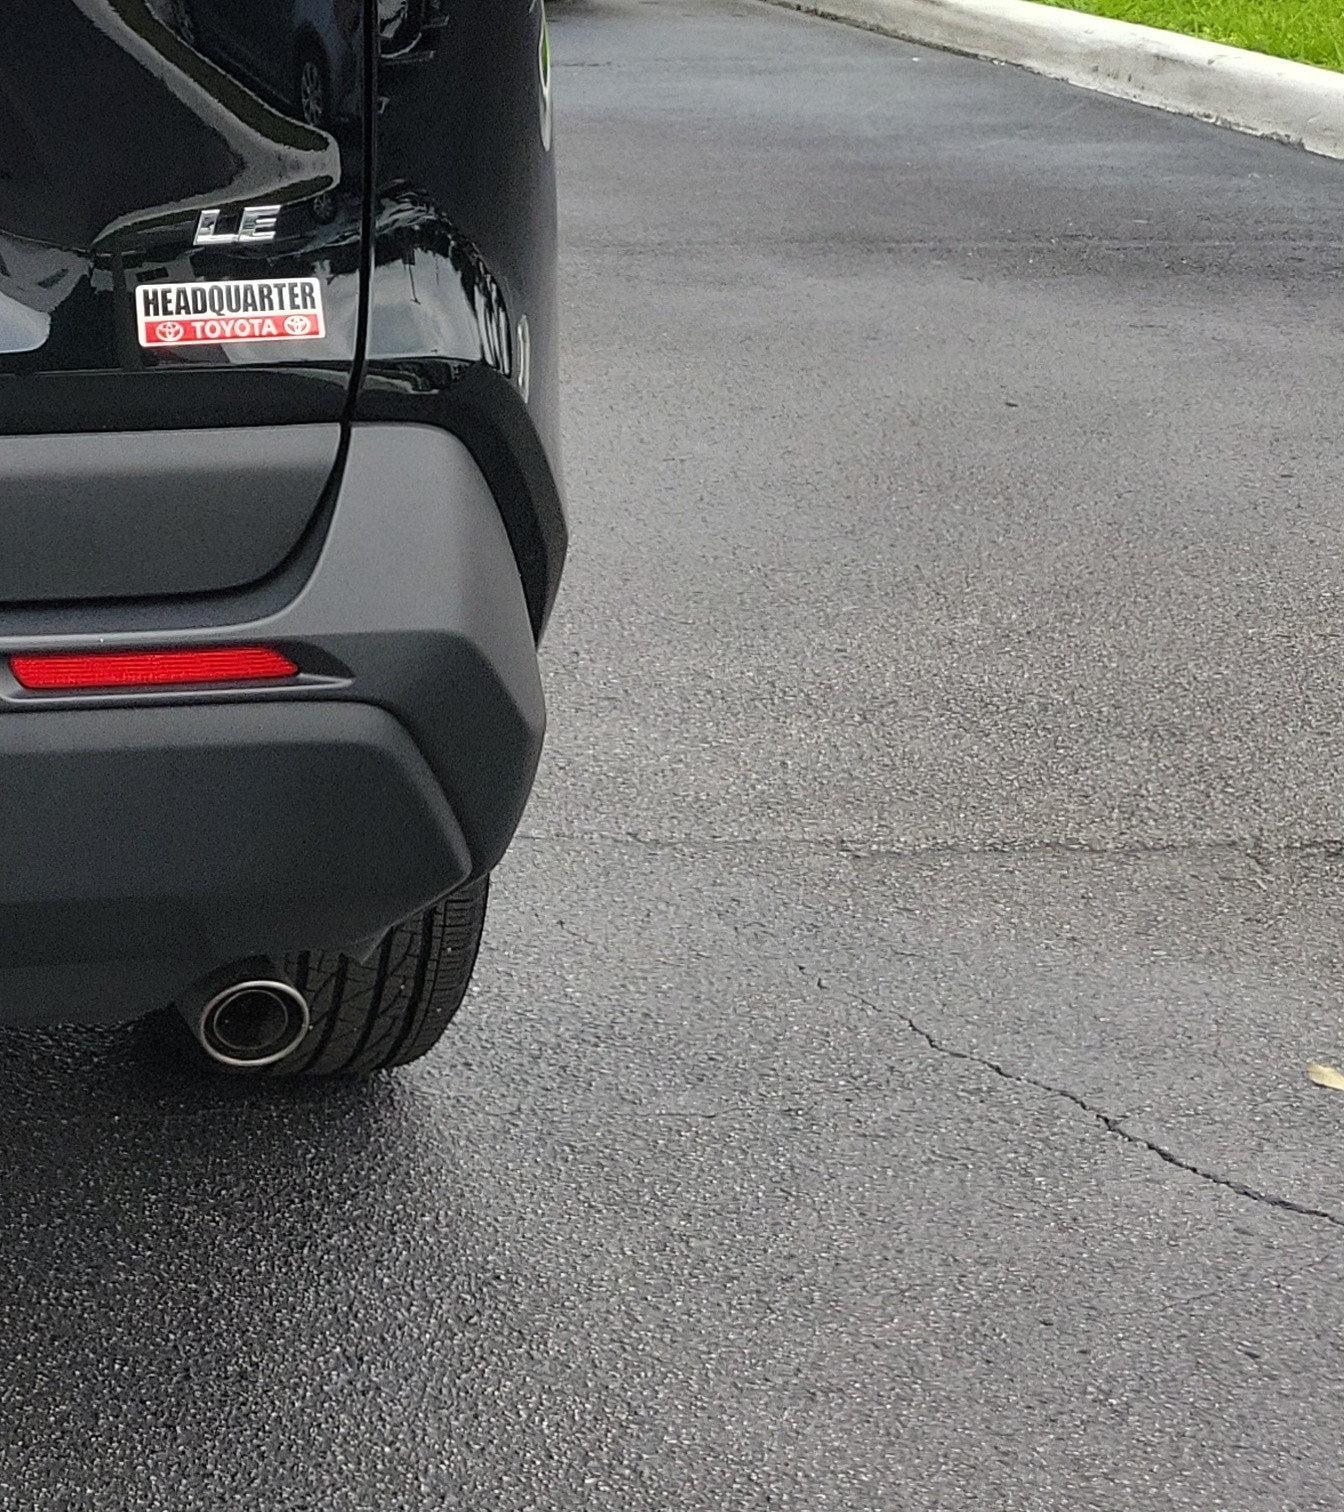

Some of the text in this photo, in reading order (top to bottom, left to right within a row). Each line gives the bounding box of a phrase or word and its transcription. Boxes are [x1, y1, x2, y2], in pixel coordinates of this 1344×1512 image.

[193, 205, 281, 245] LE
[142, 282, 316, 317] HEADQUARTER
[191, 319, 278, 339] TOYOTA
